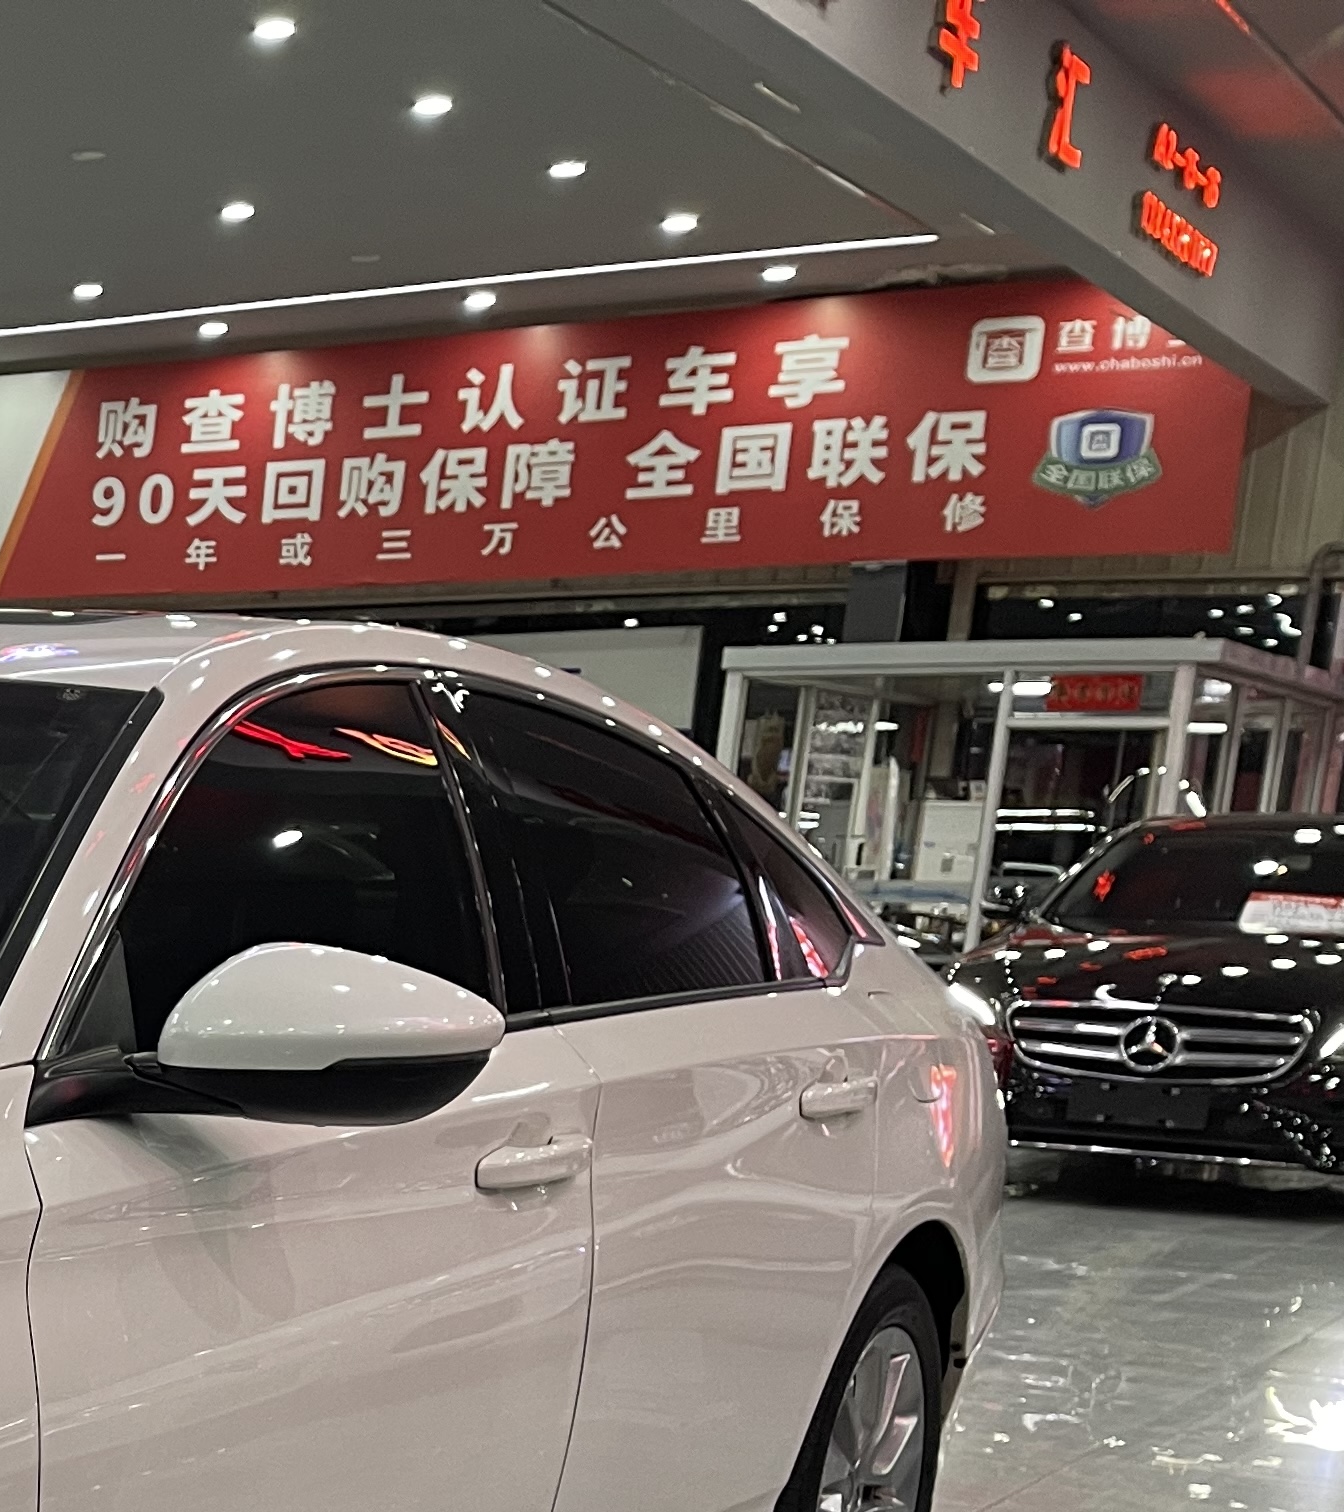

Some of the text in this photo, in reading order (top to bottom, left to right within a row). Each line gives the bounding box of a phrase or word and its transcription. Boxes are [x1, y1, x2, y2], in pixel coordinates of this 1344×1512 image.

[1056, 314, 1187, 353] 查博
[96, 334, 847, 460] 购查博士认证车享
[91, 409, 988, 527] 90天回购保障 全国联保
[95, 492, 986, 570] 一年或三万公里保修
